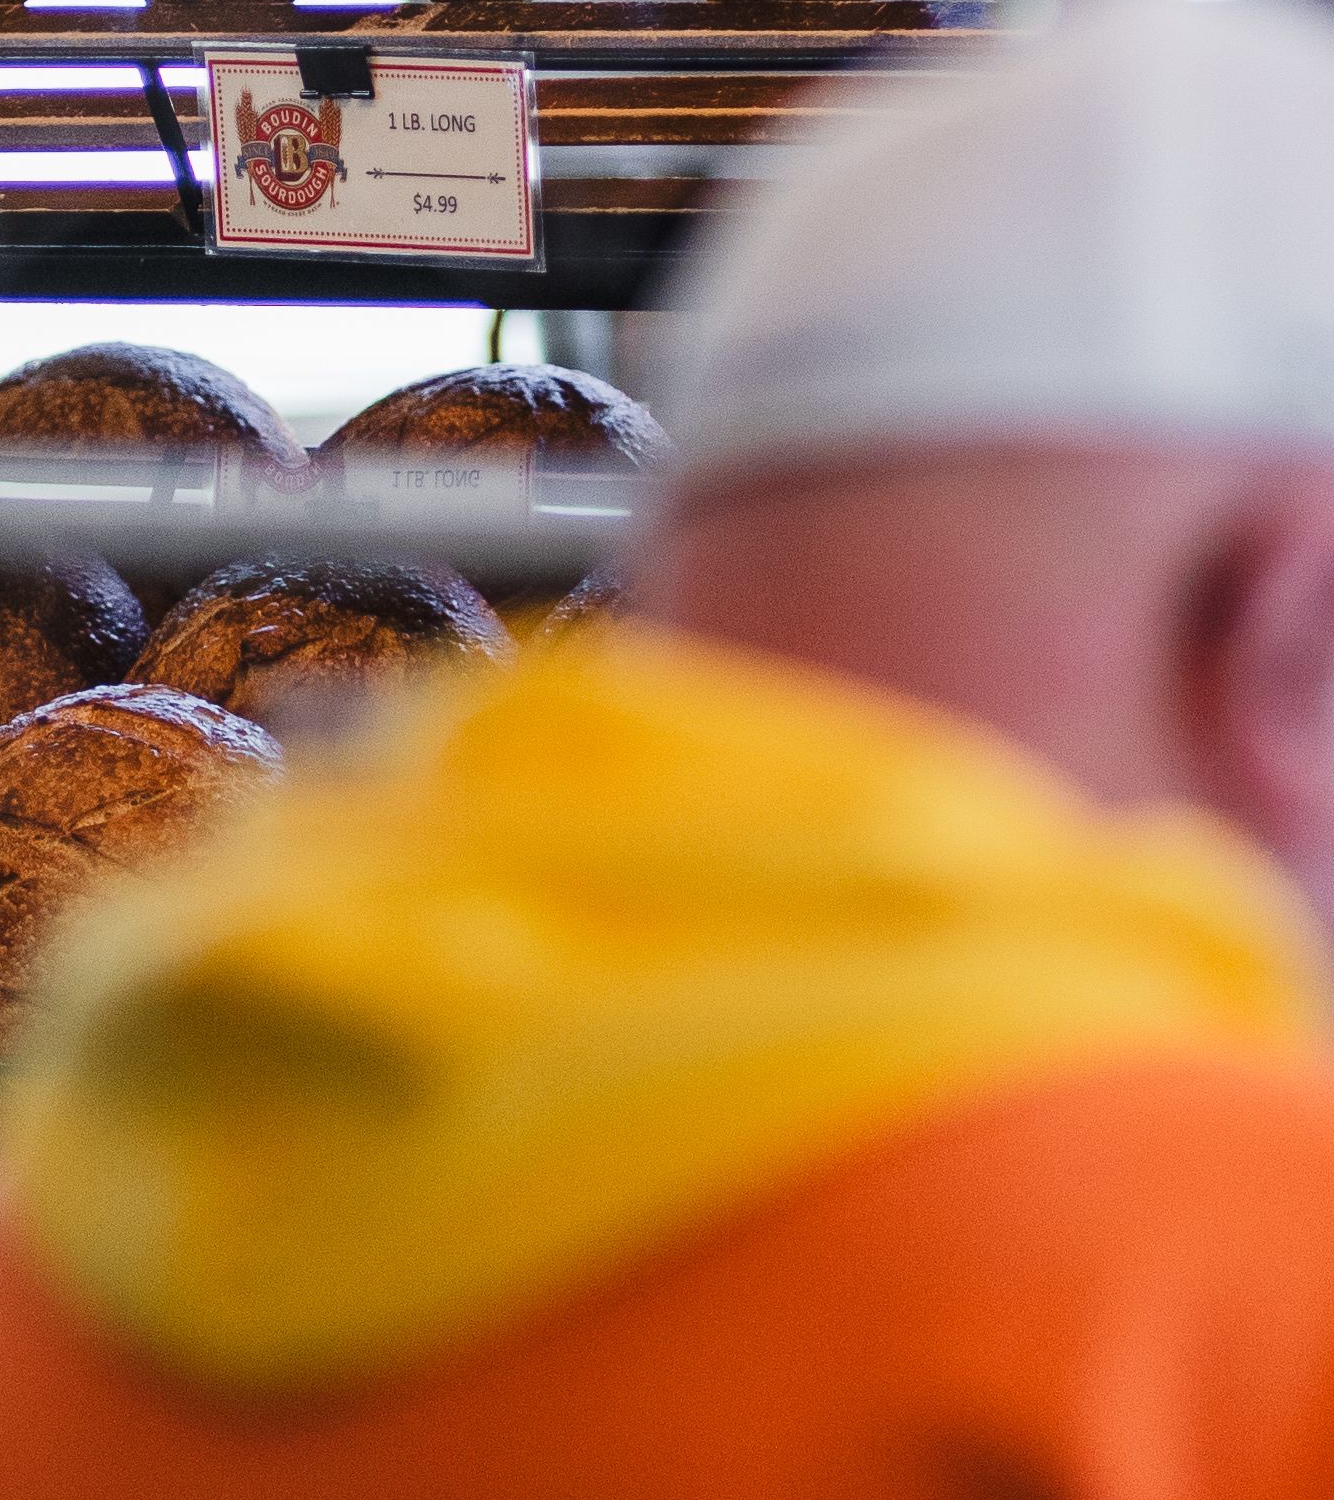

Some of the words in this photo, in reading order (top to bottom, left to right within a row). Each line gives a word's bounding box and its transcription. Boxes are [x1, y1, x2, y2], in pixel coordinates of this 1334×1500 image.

[260, 109, 319, 138] BOUDIN
[388, 112, 397, 130] 1
[402, 113, 426, 132] LB.
[430, 114, 476, 133] LONG
[273, 134, 309, 182] B
[255, 164, 328, 204] SOURDOUGH
[412, 194, 458, 214] $4.99
